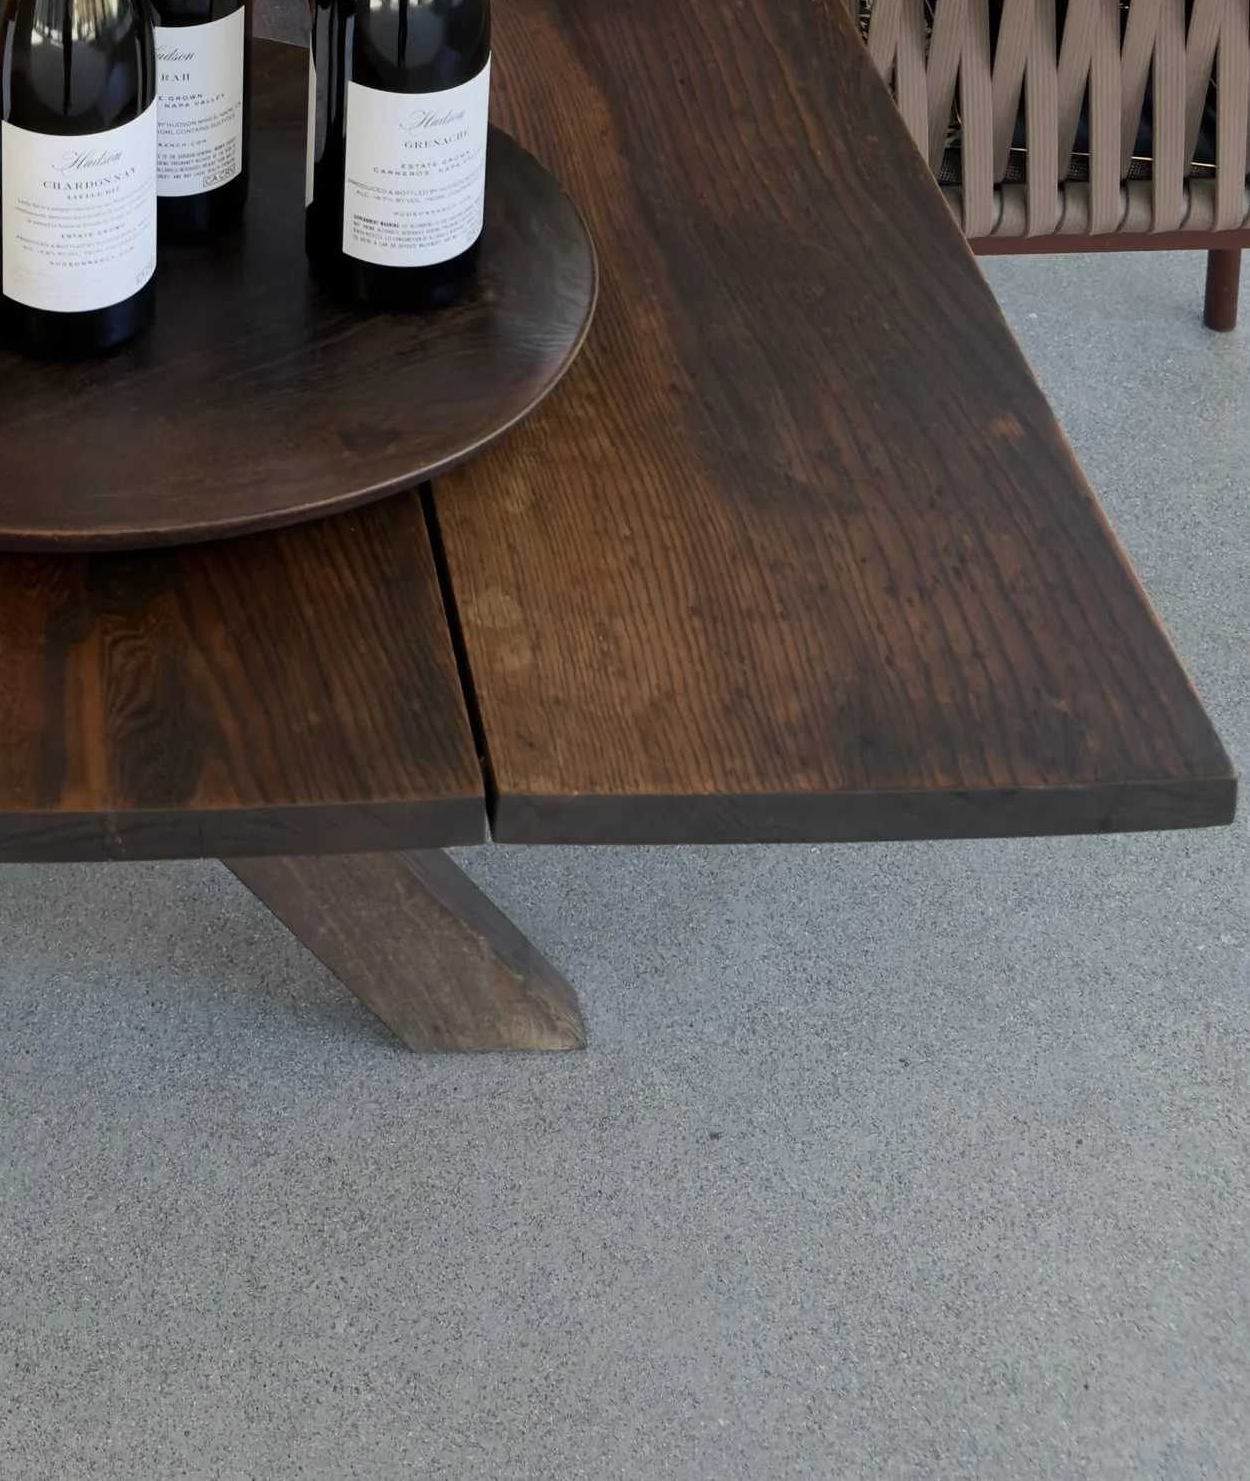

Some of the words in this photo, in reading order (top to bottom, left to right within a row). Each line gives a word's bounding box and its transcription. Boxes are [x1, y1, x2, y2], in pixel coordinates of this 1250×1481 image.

[160, 73, 190, 81] RAH
[168, 93, 204, 101] GROWN
[194, 93, 226, 106] VALLEY
[166, 119, 197, 128] HUDSON
[399, 109, 466, 136] Hudson
[404, 128, 469, 149] GRENACHE
[52, 149, 122, 178] Hudson
[442, 150, 470, 165] GROWN
[438, 163, 461, 173] NAPA
[43, 165, 137, 190] CHARDONNAY
[347, 178, 387, 194] PRODUCED
